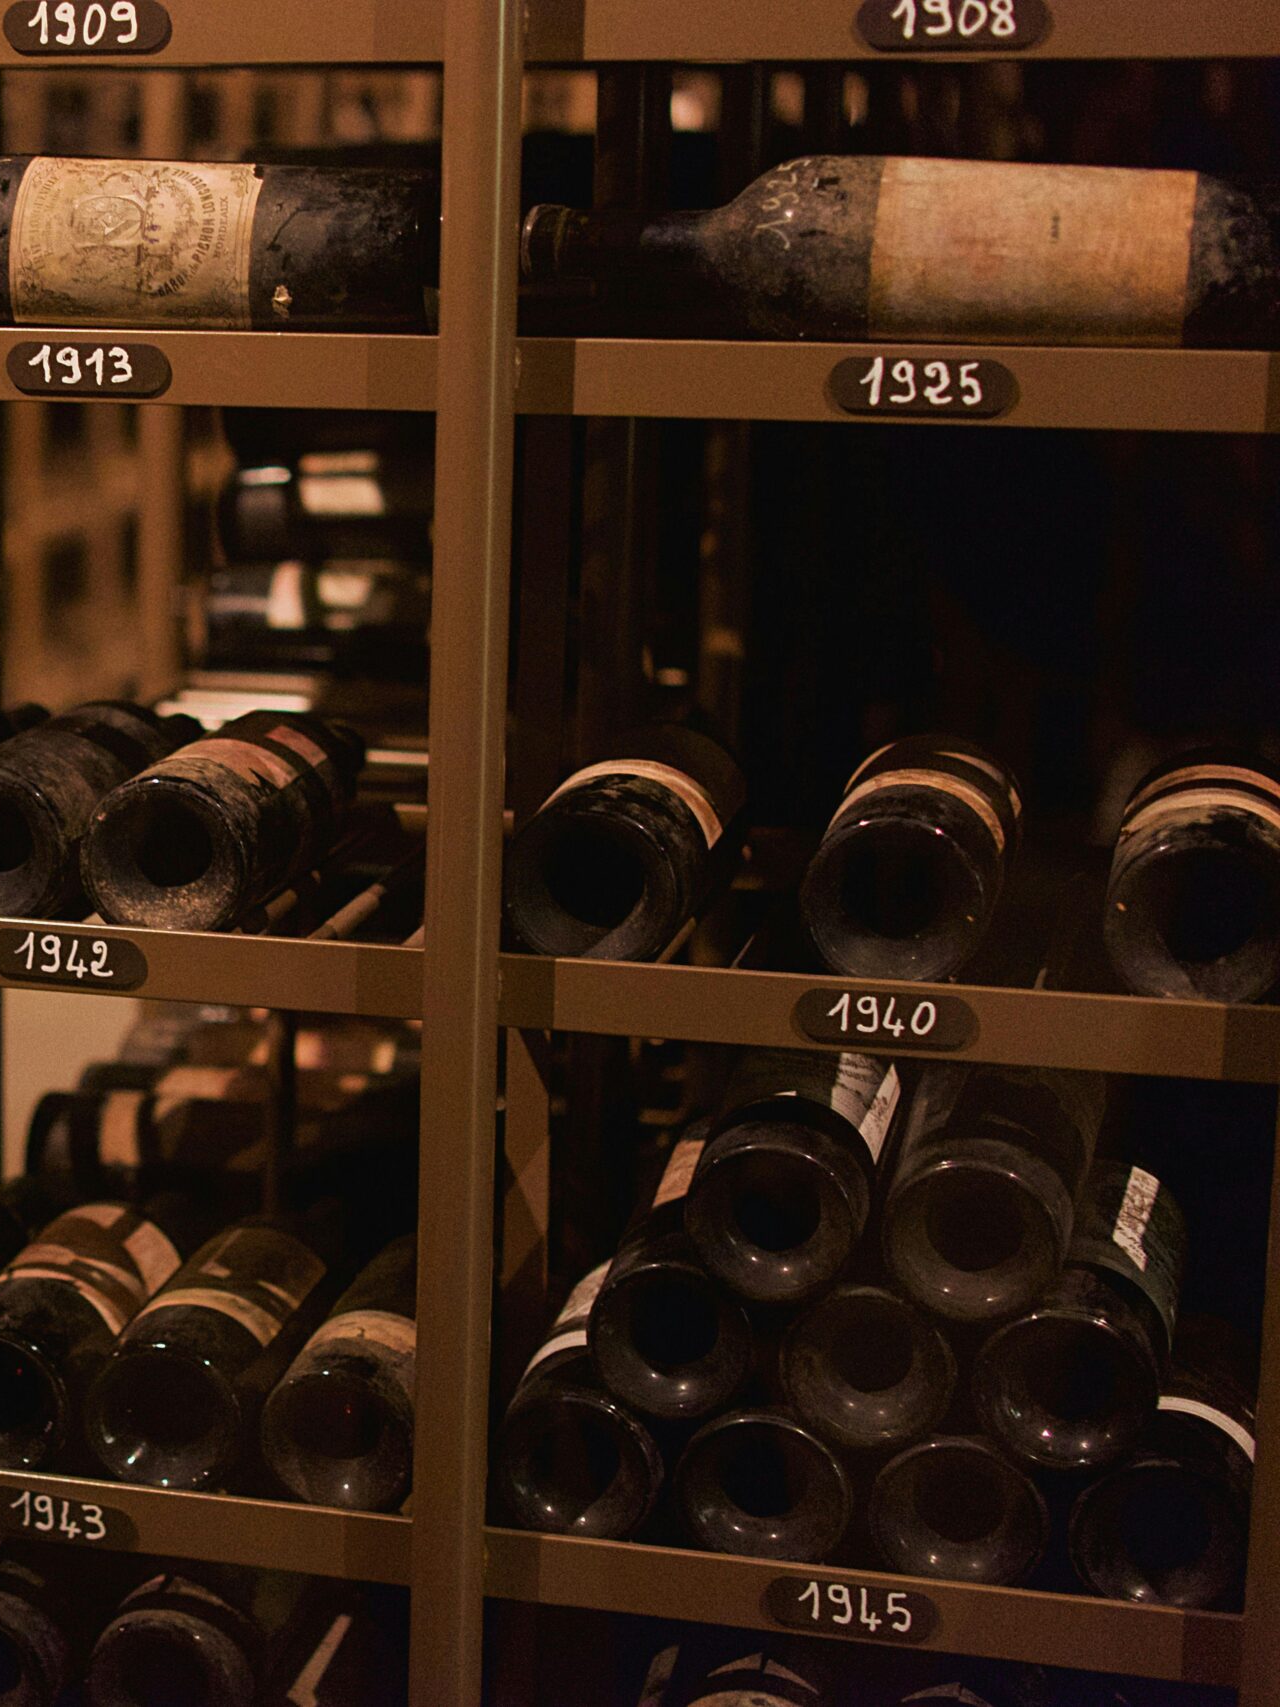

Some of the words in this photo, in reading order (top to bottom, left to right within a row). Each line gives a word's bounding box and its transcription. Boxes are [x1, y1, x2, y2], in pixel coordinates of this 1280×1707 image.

[27, 0, 138, 46] 1909
[892, 0, 1016, 38] 1908
[28, 344, 133, 386] 1913
[860, 356, 982, 406] 1925
[15, 931, 114, 979] 1942
[828, 993, 936, 1037] 1940
[11, 1491, 106, 1540] 1943
[798, 1582, 912, 1633] 1945
